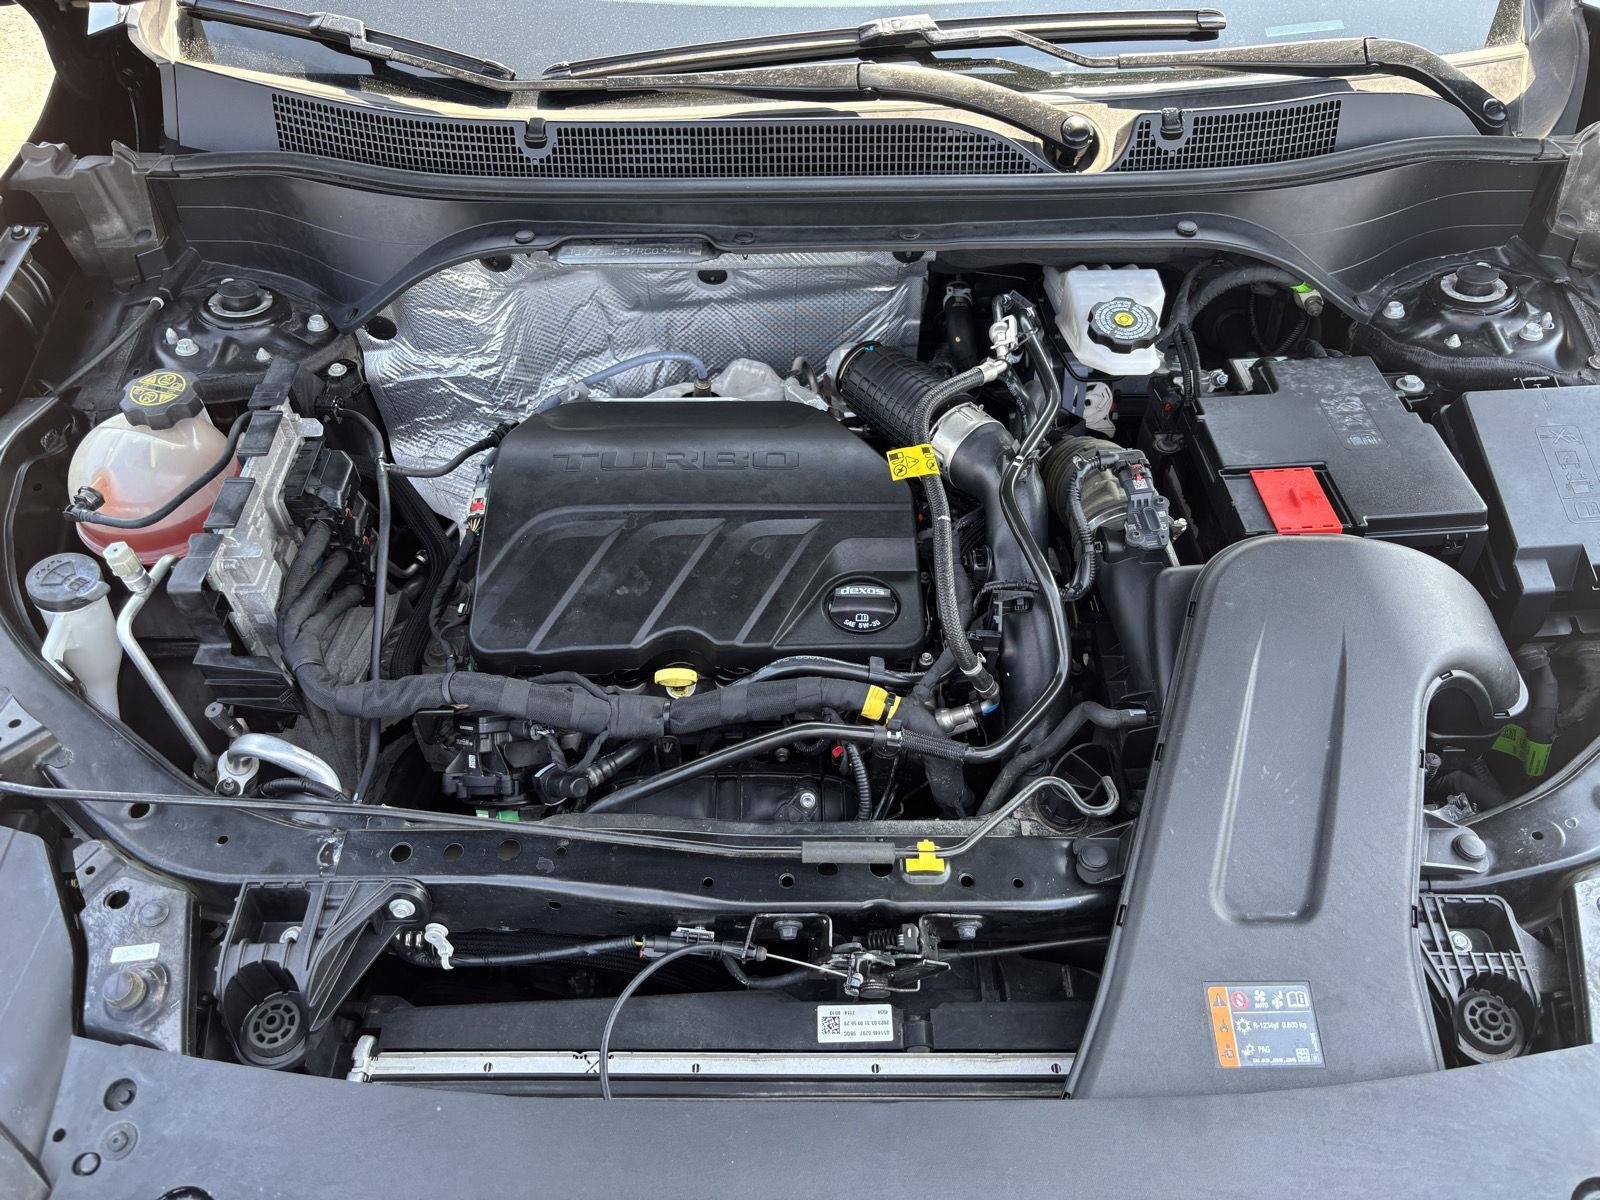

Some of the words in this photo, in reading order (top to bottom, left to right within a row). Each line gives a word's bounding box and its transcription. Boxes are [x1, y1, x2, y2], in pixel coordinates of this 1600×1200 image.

[552, 450, 800, 472] TURBO
[840, 586, 885, 595] dexos
[843, 619, 857, 628] SAE
[858, 619, 881, 629] 5W-30
